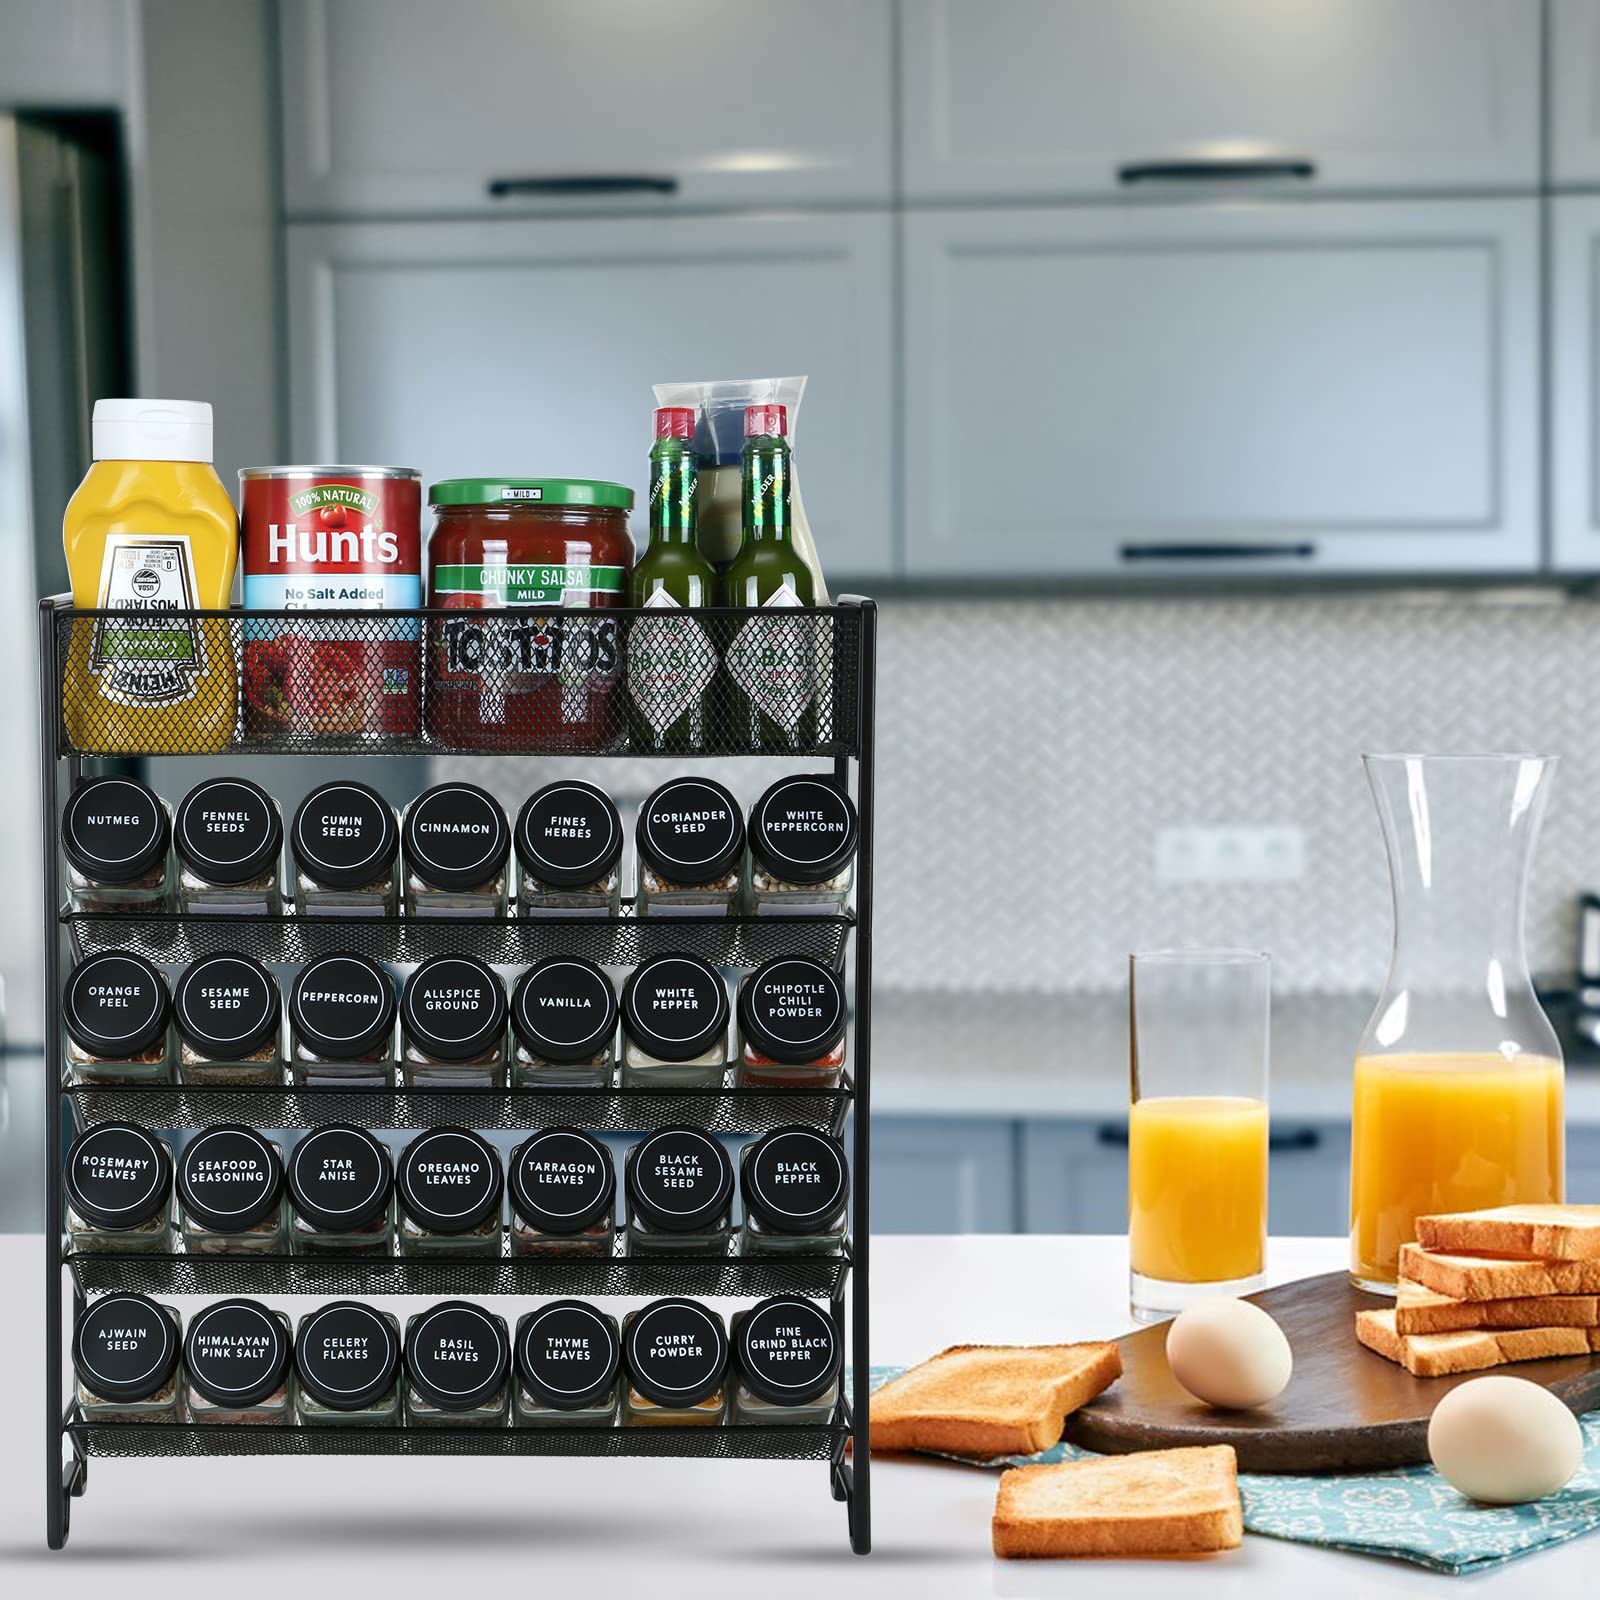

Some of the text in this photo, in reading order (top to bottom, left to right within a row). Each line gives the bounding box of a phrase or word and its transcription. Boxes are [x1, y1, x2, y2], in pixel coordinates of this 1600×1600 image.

[513, 490, 530, 498] MILD
[751, 474, 776, 505] MILDER
[295, 489, 372, 511] 100% NATURAL
[479, 570, 584, 587] CHUNKY SALSA
[137, 584, 154, 592] USDA
[284, 588, 384, 600] No Salt Added
[516, 589, 546, 600] MILD
[87, 815, 140, 826] NUTMEG
[202, 811, 251, 822] FENNEL
[321, 815, 363, 826] CUMIN
[550, 815, 587, 827] FINES
[652, 810, 726, 824] CORIANDER
[785, 810, 824, 821] WHITE
[206, 822, 245, 833] SEEDS
[322, 826, 361, 838] SEEDS
[419, 822, 490, 834] CINNAMON
[674, 822, 706, 834] SEED
[766, 822, 844, 832] PEPPERCORN
[544, 827, 592, 839] HERBES
[88, 986, 141, 996] ORANGE
[200, 987, 250, 998] SESAME
[423, 988, 481, 999] ALLSPICE
[655, 988, 695, 998] WHITE
[764, 984, 825, 995] CHIPOTLE
[99, 997, 129, 1008] PEEL
[302, 991, 379, 1005] PEPPERCORN
[539, 997, 592, 1008] VANILLA
[778, 995, 812, 1006] CHILI
[209, 999, 241, 1010] SEED
[425, 1000, 479, 1011] GROUND
[652, 999, 699, 1010] PEPPER
[769, 1007, 822, 1018] POWDER
[82, 1155, 150, 1170] ROSEMARY
[198, 1159, 257, 1171] SEAFOOD
[322, 1159, 353, 1169] STAR
[659, 1154, 699, 1165] BLACK
[417, 1162, 480, 1173] OREGANO
[528, 1161, 596, 1174] TARRAGON
[654, 1166, 704, 1177] SESAME
[777, 1161, 817, 1173] BLACK
[91, 1167, 137, 1181] LEAVES
[191, 1171, 264, 1183] SEASONING
[318, 1170, 356, 1181] ANISE
[426, 1174, 471, 1185] LEAVES
[539, 1173, 584, 1185] LEAVES
[774, 1173, 821, 1184] PEPPER
[663, 1177, 695, 1188] SEED
[98, 1328, 147, 1339] AJWAIN
[775, 1326, 802, 1337] FINE
[106, 1340, 138, 1351] SEED
[197, 1335, 270, 1347] HIMALAYAN
[323, 1337, 369, 1348] CELERY
[439, 1338, 474, 1350] BASIL
[547, 1337, 589, 1349] THYME
[655, 1334, 696, 1346] CURRY
[750, 1337, 828, 1350] GRIND BLACK
[201, 1347, 266, 1359] PINK SALT
[323, 1349, 369, 1360] FLAKES
[433, 1350, 479, 1362] LEAVES
[545, 1349, 591, 1361] LEAVES
[650, 1346, 703, 1358] POWDER
[769, 1350, 811, 1361] PEPPER
